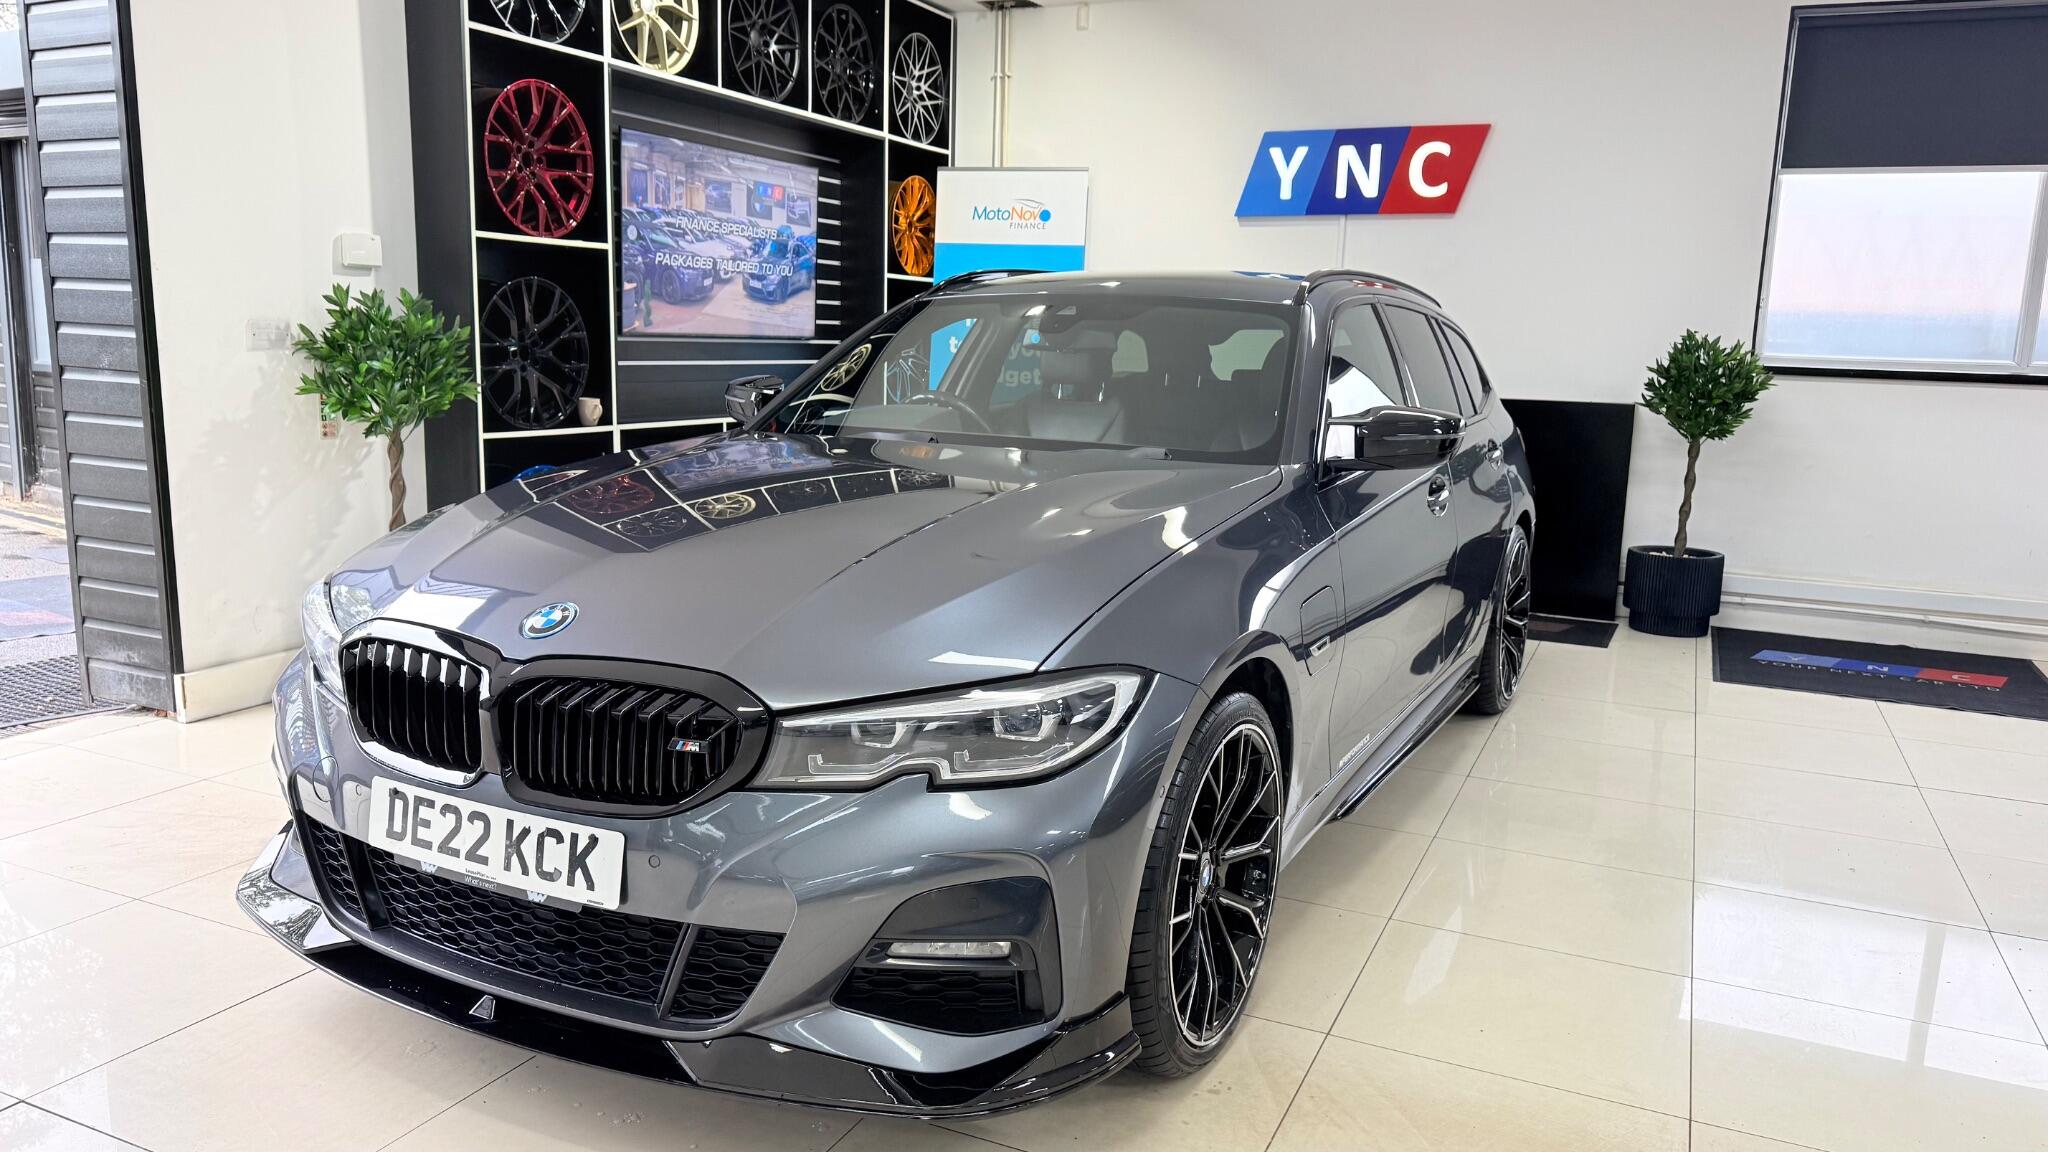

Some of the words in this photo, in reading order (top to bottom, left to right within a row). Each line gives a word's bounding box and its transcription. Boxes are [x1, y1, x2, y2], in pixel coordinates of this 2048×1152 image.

[1268, 140, 1452, 200] YNC
[675, 216, 720, 233] FINANCE
[721, 222, 778, 240] SPECIALISTS
[1009, 222, 1047, 230] FINANCE
[654, 252, 713, 269] PACKAGES
[716, 258, 760, 273] TAILORED
[762, 263, 773, 275] TO
[776, 265, 794, 276] YOU
[385, 786, 492, 867] DE22
[503, 817, 600, 892] KCK
